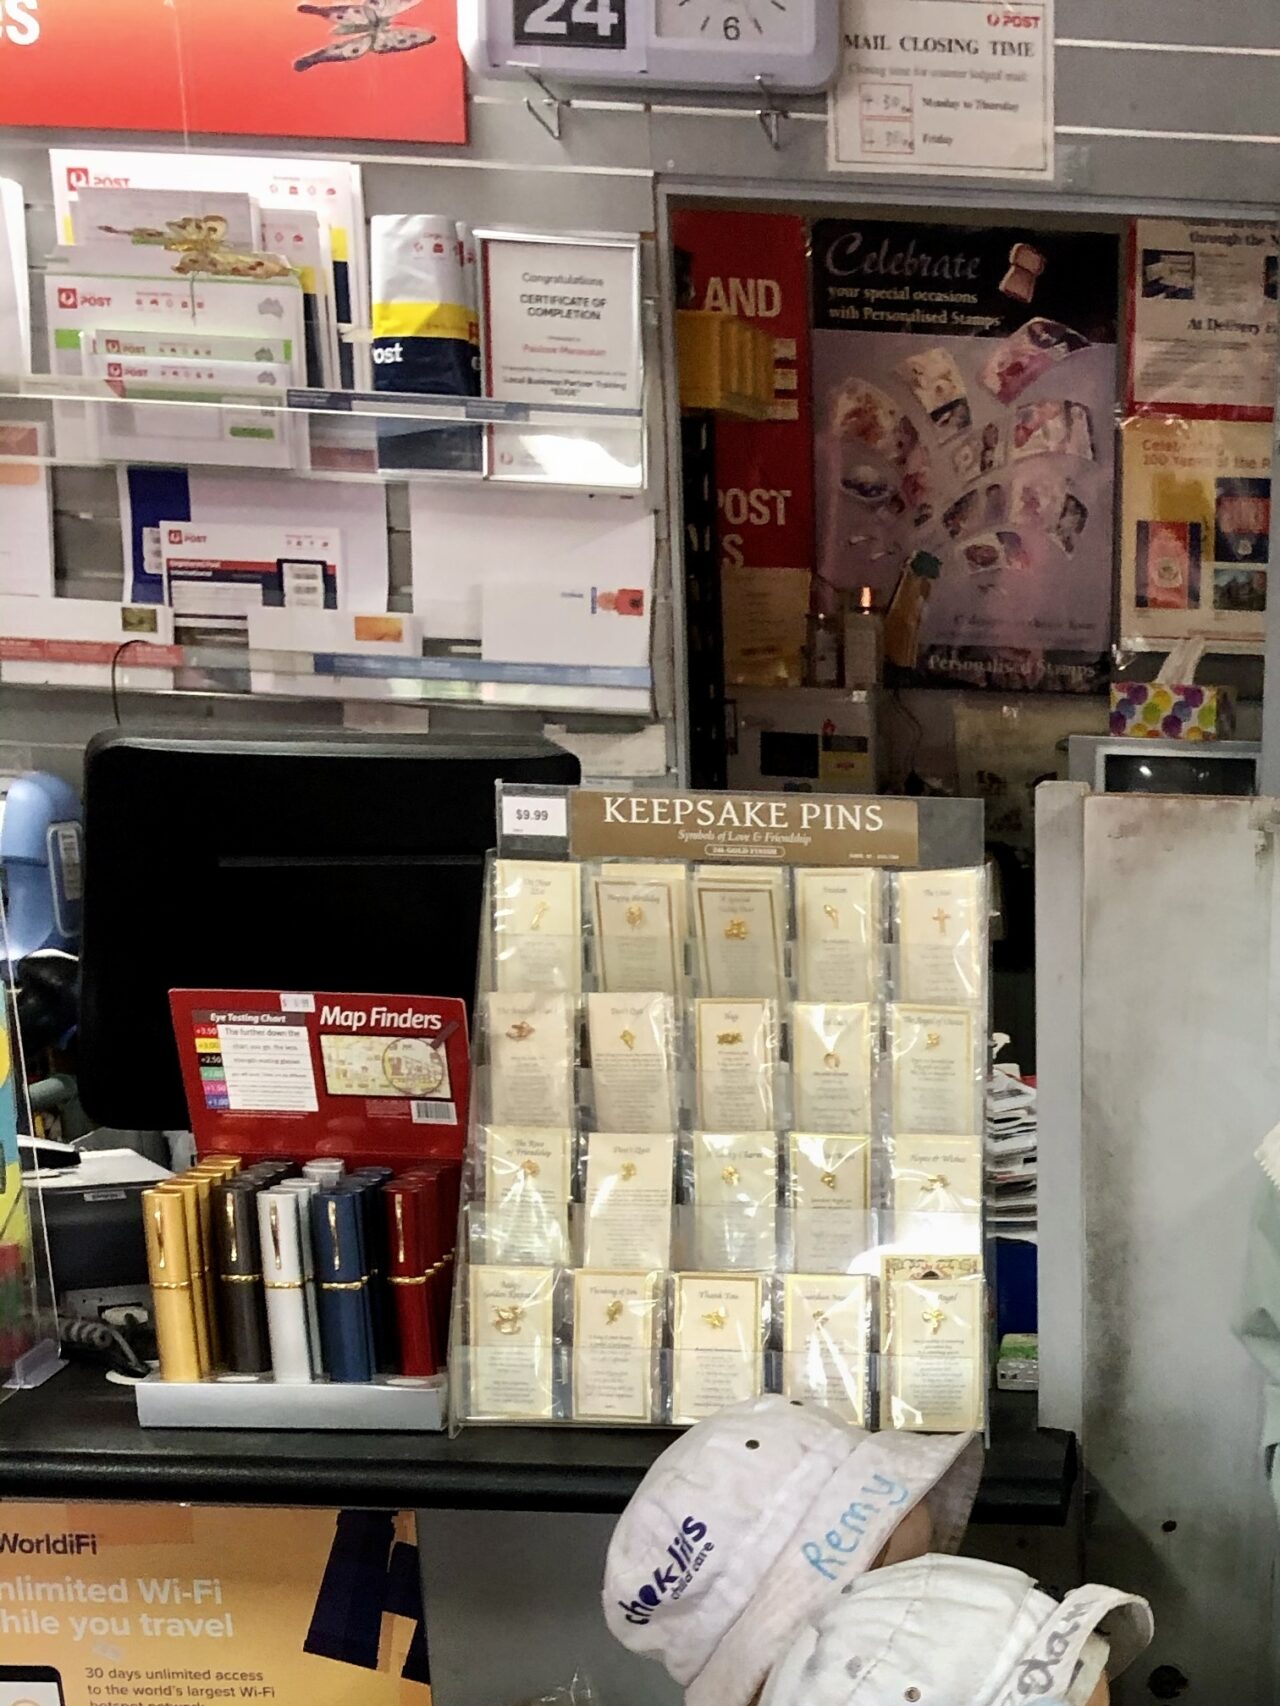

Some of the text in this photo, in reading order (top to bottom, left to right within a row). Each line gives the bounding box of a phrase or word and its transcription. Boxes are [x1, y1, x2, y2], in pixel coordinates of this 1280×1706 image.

[524, 0, 618, 36] 24
[1002, 15, 1040, 28] POST
[723, 16, 740, 40] 6
[843, 34, 1035, 57] MAIL CLOSING TIME
[825, 232, 981, 280] Celebrate
[522, 272, 604, 286] Congratulations
[80, 297, 112, 307] POST
[520, 293, 589, 307] CERTIFICATE
[704, 277, 782, 318] AND
[828, 286, 978, 303] your special occasions
[527, 306, 601, 320] COMPLETION
[829, 306, 1000, 329] with Personalised Stamps
[373, 343, 403, 364] ost
[516, 809, 548, 821] $9.99
[603, 797, 883, 832] KEEPSAKE PINS
[678, 829, 812, 846] Symbols of Love & Friendship
[210, 1012, 287, 1024] Eye Testing Chart
[320, 1005, 442, 1031] Map Finders
[225, 1027, 300, 1037] The further down the
[802, 1473, 909, 1581] Remy
[0, 1575, 223, 1604] nlimited Wi-Fi
[0, 1608, 234, 1641] hile you travel
[85, 1667, 264, 1682] 30 days unlimited access
[88, 1684, 275, 1700] to the world's largest Wi-Fi
